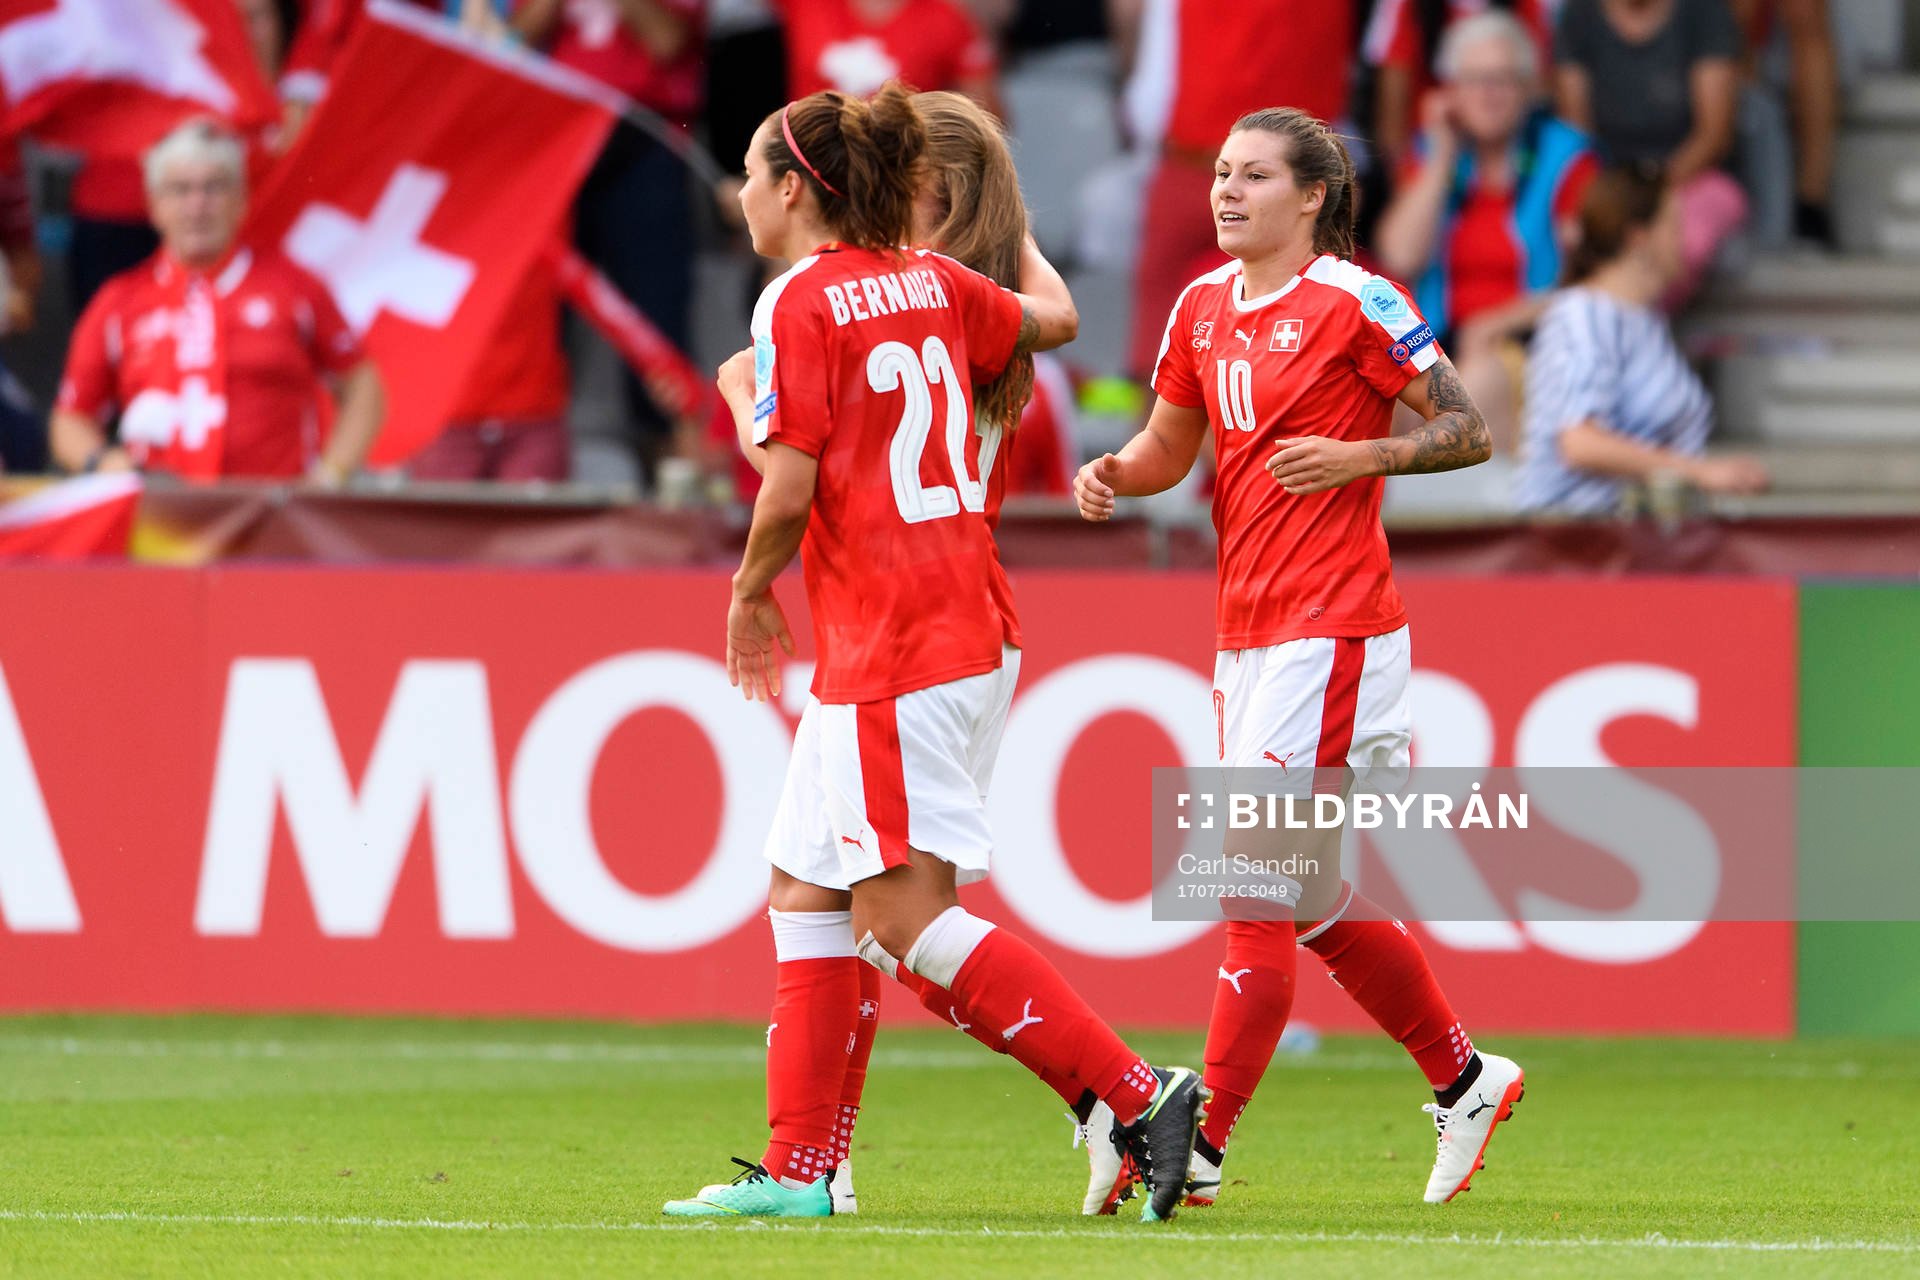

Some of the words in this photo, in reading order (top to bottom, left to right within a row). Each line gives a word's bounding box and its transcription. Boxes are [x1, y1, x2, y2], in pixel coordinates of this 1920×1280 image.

[1406, 326, 1433, 349] RESPEC
[1217, 359, 1257, 433] 10
[195, 648, 1722, 963] MOORS
